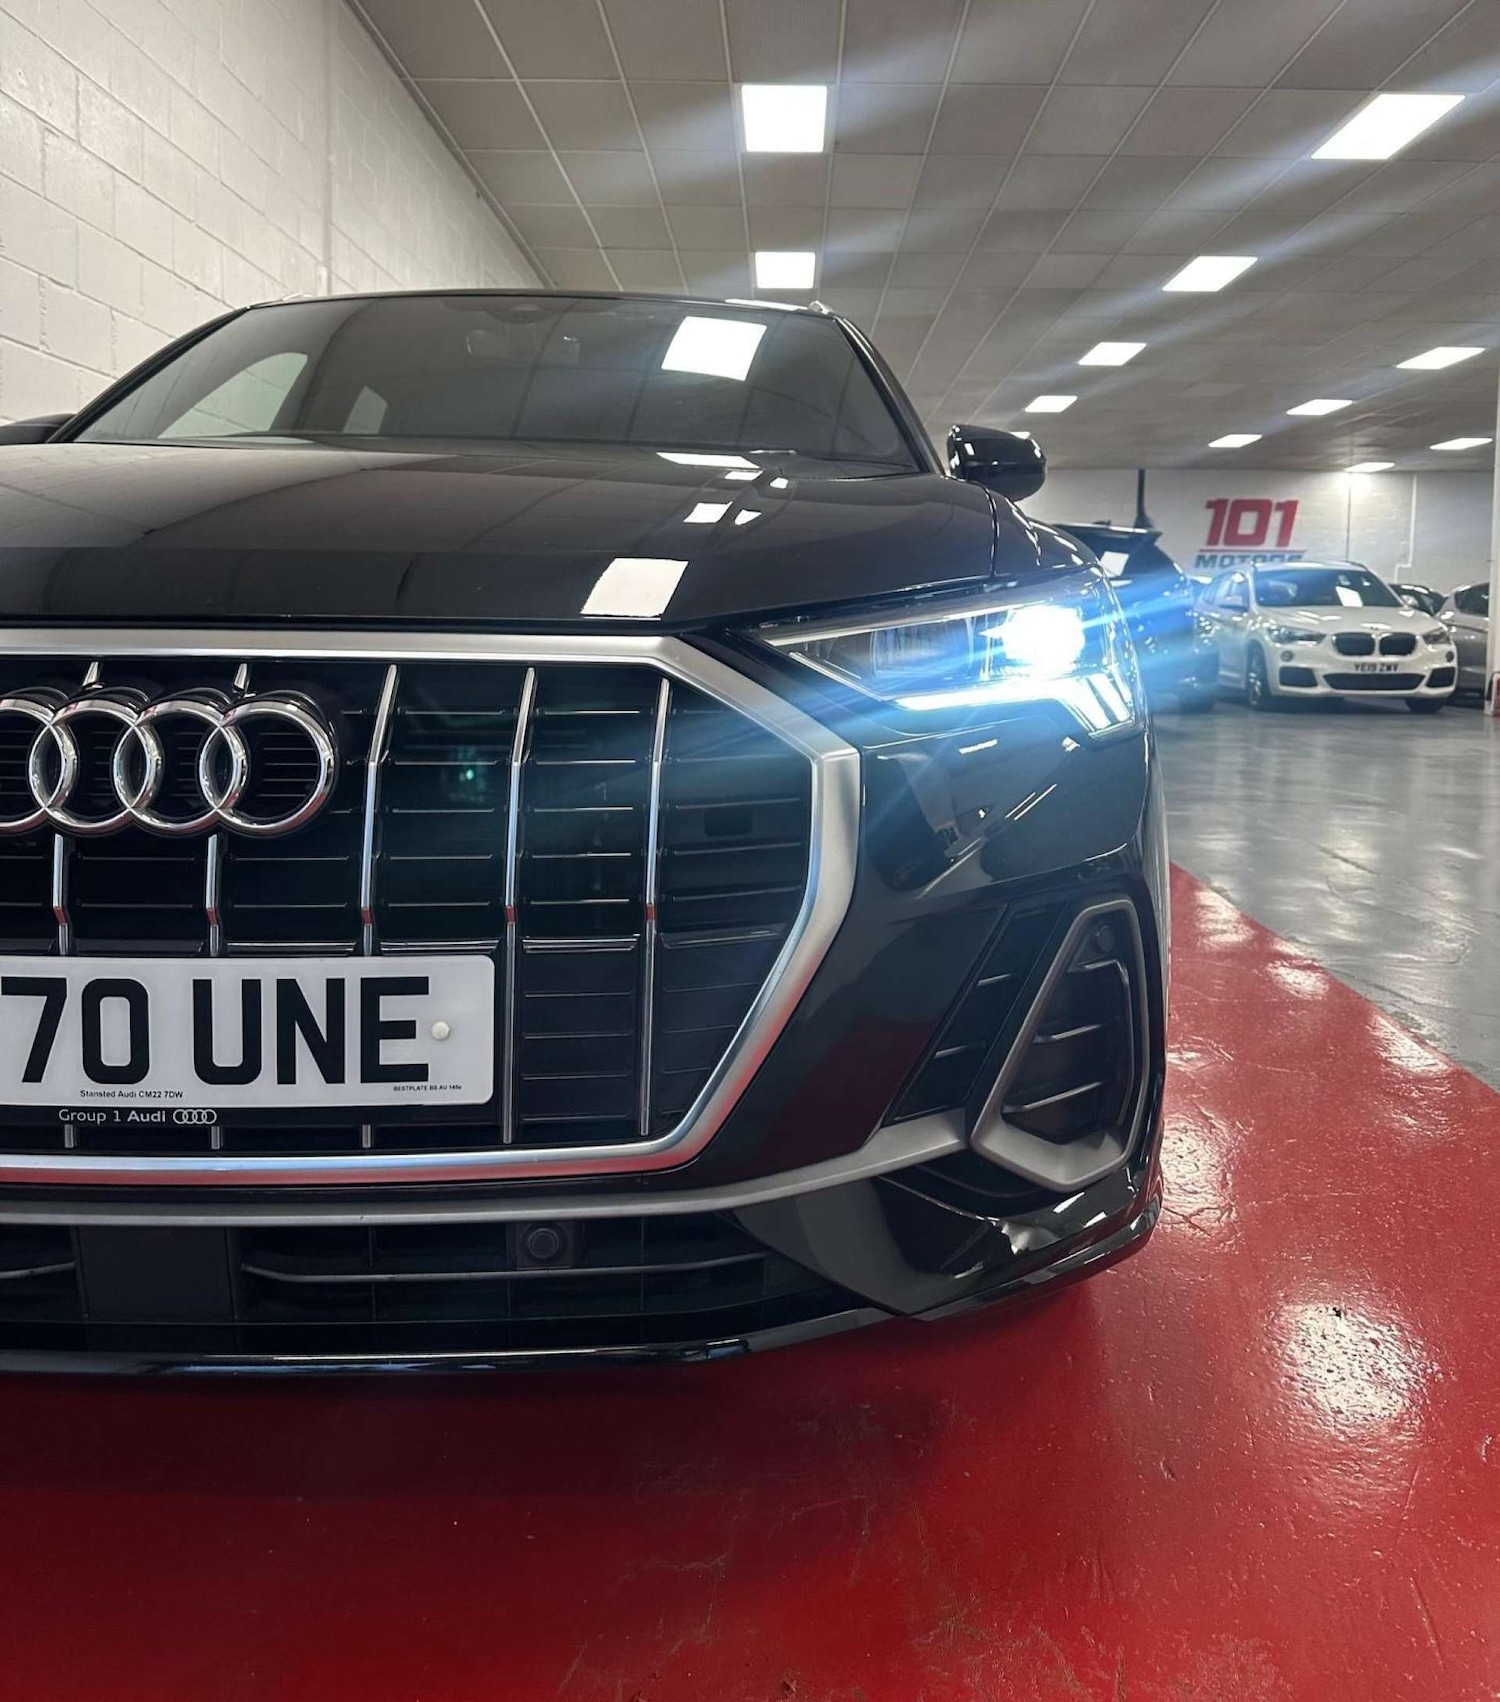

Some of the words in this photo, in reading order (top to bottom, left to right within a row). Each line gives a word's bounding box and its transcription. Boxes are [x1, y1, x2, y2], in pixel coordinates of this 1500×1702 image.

[1205, 498, 1298, 547] 101
[1354, 661, 1377, 672] YE19
[1, 976, 150, 1084] 70
[193, 976, 429, 1085] UNE
[80, 1089, 116, 1099] Stansted
[118, 1089, 137, 1099] Audi
[138, 1089, 162, 1099] CM22
[164, 1090, 184, 1099] 7DW
[58, 1109, 107, 1125] Group
[113, 1110, 122, 1122] 1
[127, 1109, 166, 1123] Audi
